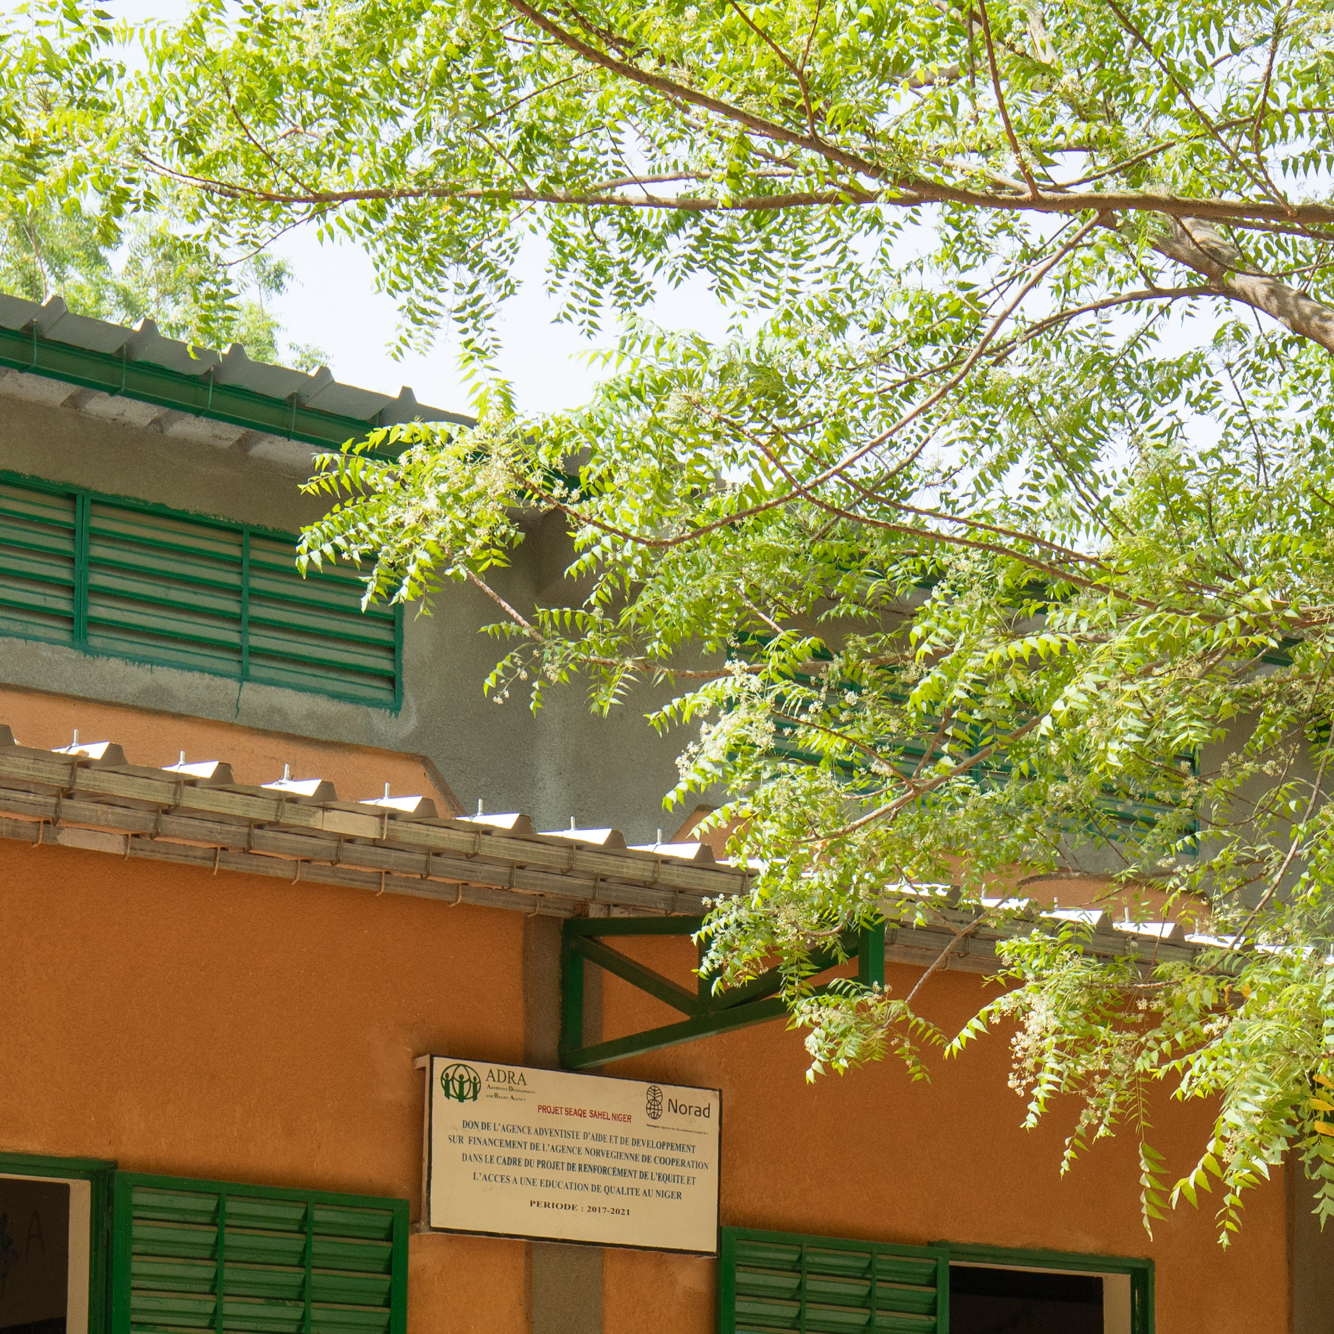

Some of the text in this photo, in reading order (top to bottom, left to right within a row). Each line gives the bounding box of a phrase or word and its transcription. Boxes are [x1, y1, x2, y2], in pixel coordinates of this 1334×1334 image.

[486, 1068, 527, 1085] ADRA
[537, 1104, 632, 1123] PROJET SEAQE SAHEL NIGER
[668, 1098, 711, 1119] Norad
[462, 1120, 696, 1154] DON DE L'AGENCE ADVENTISTE D'AIDE ET DE DEVELOPPEMENT
[448, 1134, 709, 1171] SUR FINANCEMENT DE L'AGENCE NORVEGIENNE DE COOPERATION
[461, 1152, 483, 1163] DANS
[484, 1154, 495, 1165] LE
[496, 1155, 523, 1167] CADRE
[524, 1158, 535, 1169] DU
[537, 1160, 565, 1172] PROJET
[567, 1162, 577, 1172] DE
[639, 1171, 649, 1180] DE
[650, 1172, 685, 1186] L'EQUITE
[686, 1176, 697, 1186] ET
[473, 1172, 683, 1200] L'ACCES A UNE EDUCATION DE QUALITE AU NIGER
[529, 1200, 578, 1212] PERIODE
[587, 1205, 631, 1216] 2017-2021
